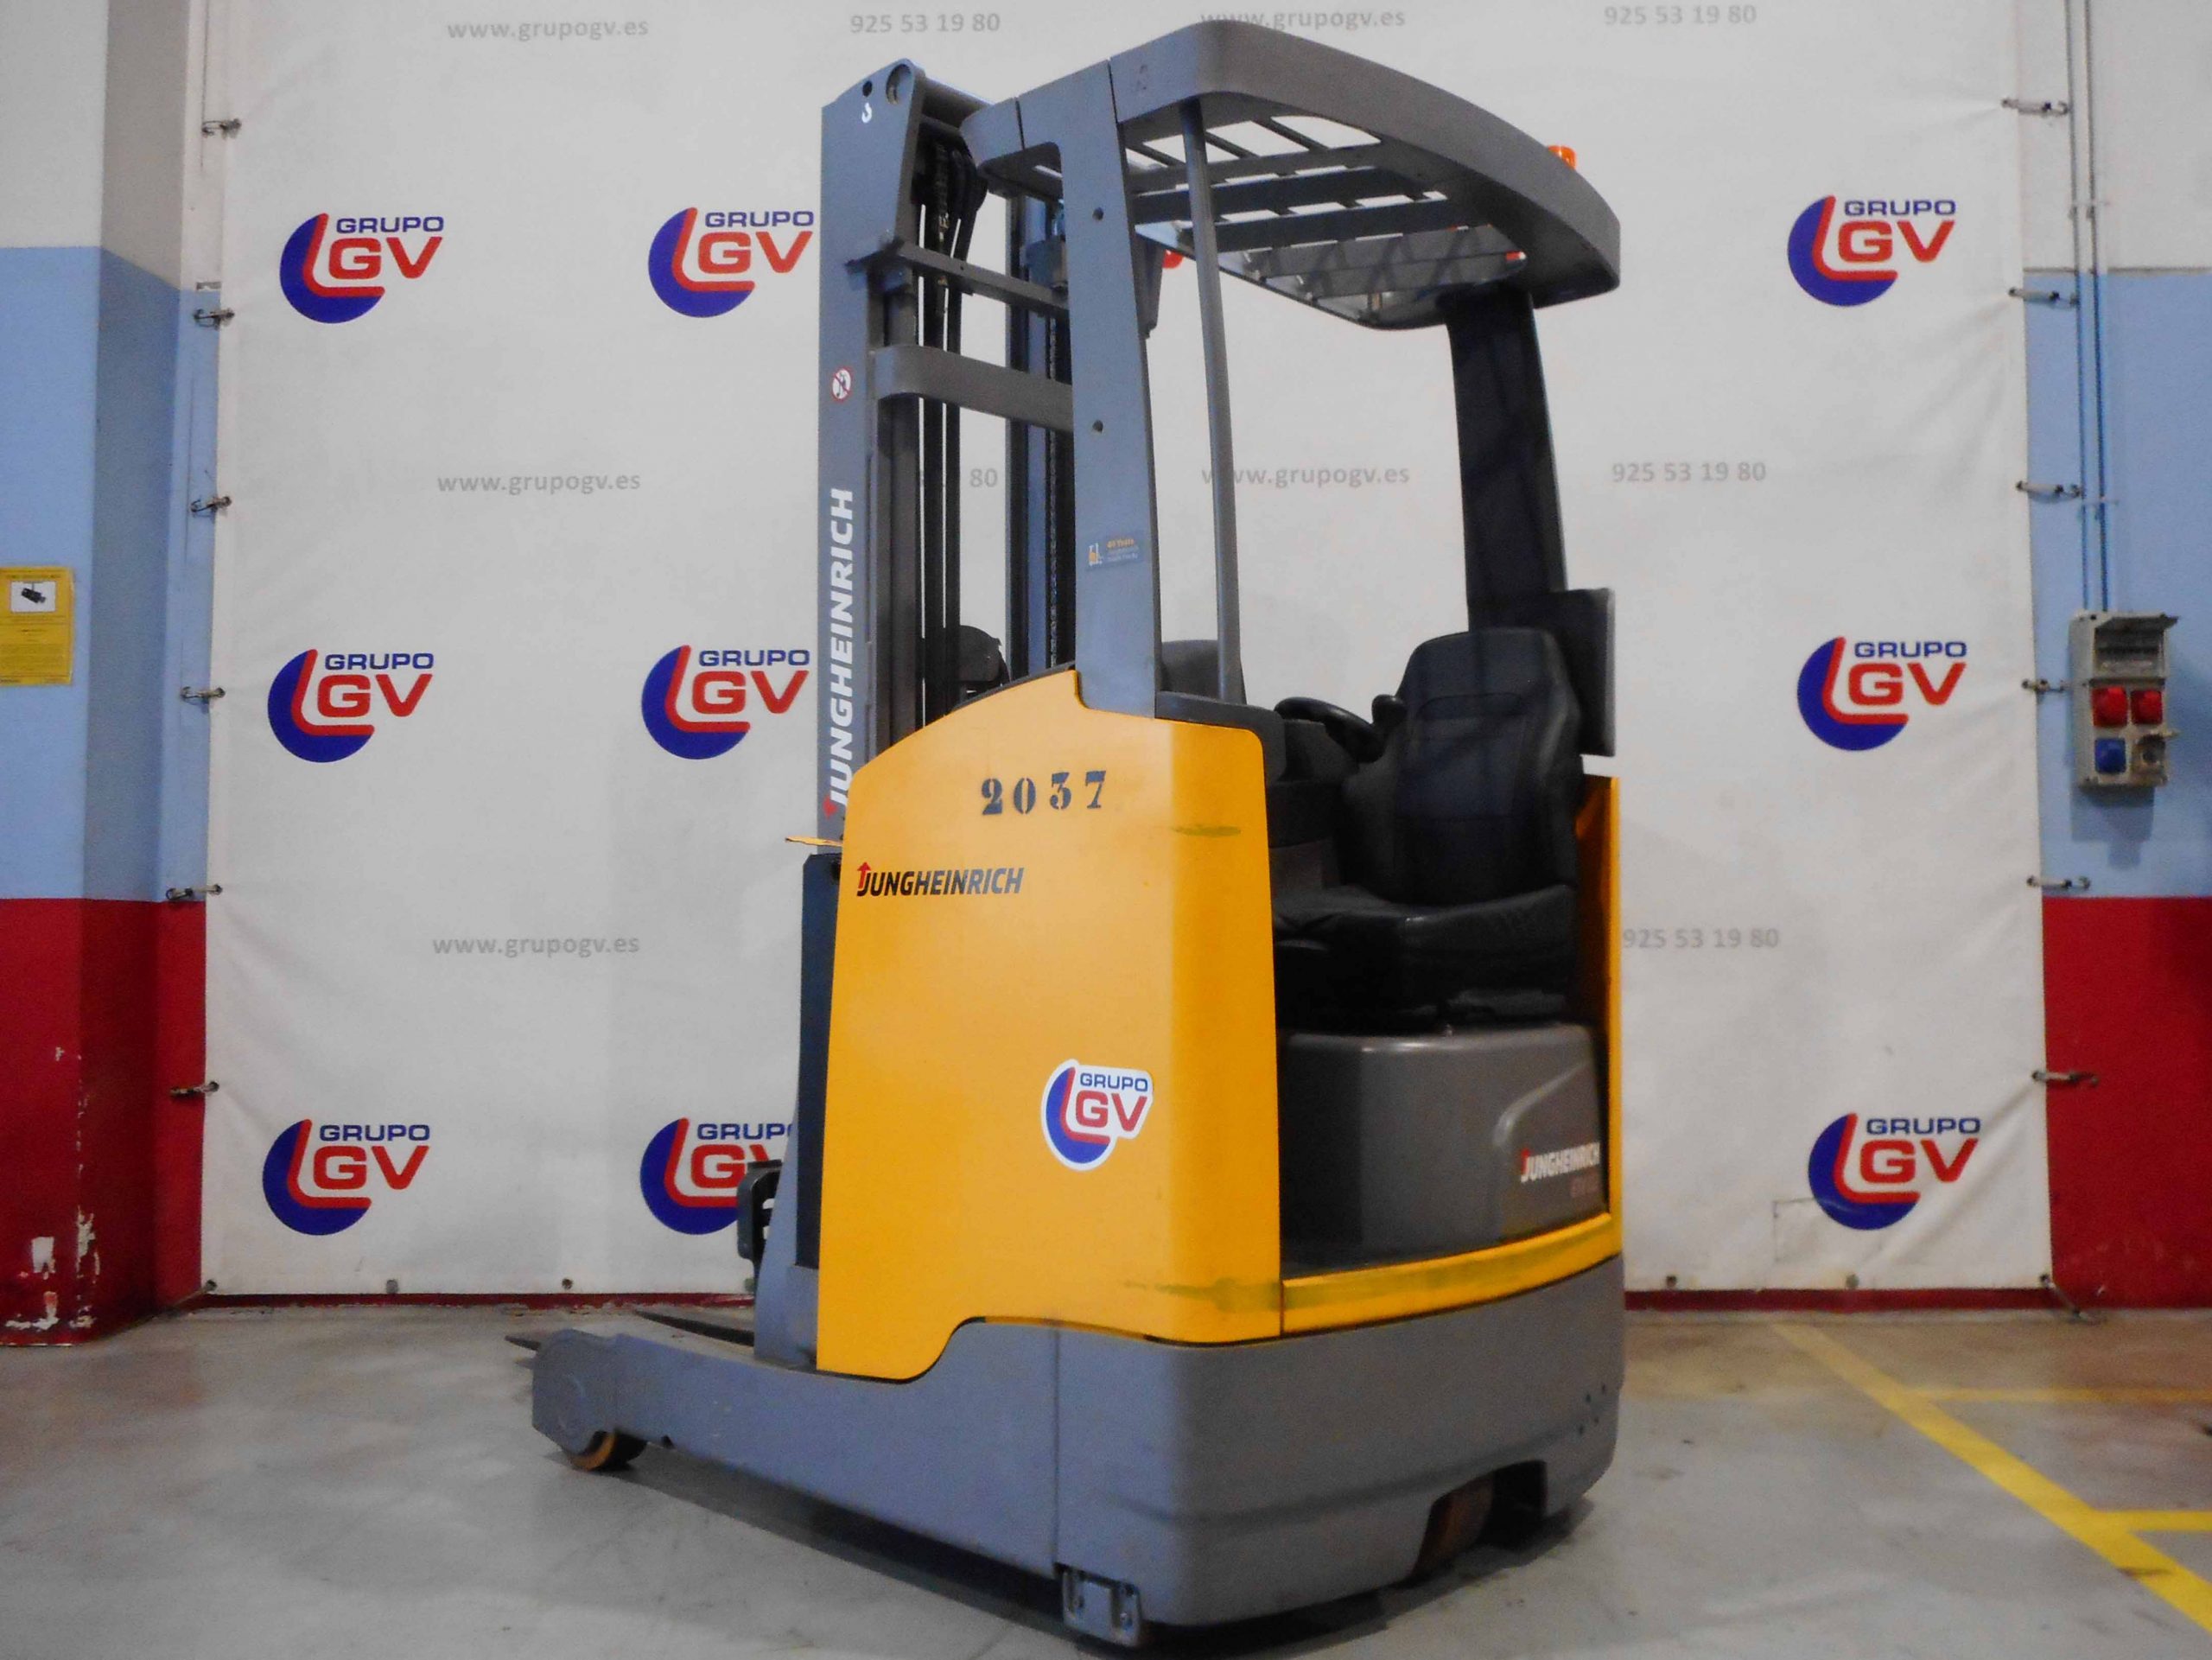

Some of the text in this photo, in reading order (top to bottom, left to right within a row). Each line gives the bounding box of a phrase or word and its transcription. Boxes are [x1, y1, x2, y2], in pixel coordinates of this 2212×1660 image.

[850, 13, 1001, 34] 925 53 19 80
[1605, 4, 1757, 25] 925 53 19 80
[447, 20, 649, 42] www.grupogv.es
[1845, 200, 1956, 215] GRUPO
[336, 216, 444, 232] GRUPO
[705, 212, 814, 226] GRUPO
[698, 232, 813, 274] GV
[1838, 220, 1955, 264] GV
[328, 237, 443, 279] GV
[969, 467, 998, 487] 80
[1611, 461, 1766, 483] 925 53 19 80
[437, 472, 641, 496] www.grupogv.es
[830, 487, 854, 805] JUNGHEINRICH
[1854, 641, 1967, 658] GRUPO
[324, 652, 435, 670] GRUPO
[698, 650, 810, 666] GRUPO
[692, 671, 809, 715] GV
[1847, 663, 1967, 706] GV
[317, 674, 433, 718] GV
[981, 770, 1107, 815] 2037
[856, 867, 1025, 897] JUNGHEINRICH
[432, 935, 640, 958] www.grupogv.es
[1624, 928, 1780, 949] 925 53 19 80
[1080, 1072, 1148, 1091] GRUPO
[1076, 1090, 1147, 1131] GV
[320, 1124, 430, 1141] GRUPO
[1866, 1117, 1981, 1135] GRUPO
[313, 1145, 429, 1190] GV
[1859, 1138, 1979, 1185] GV
